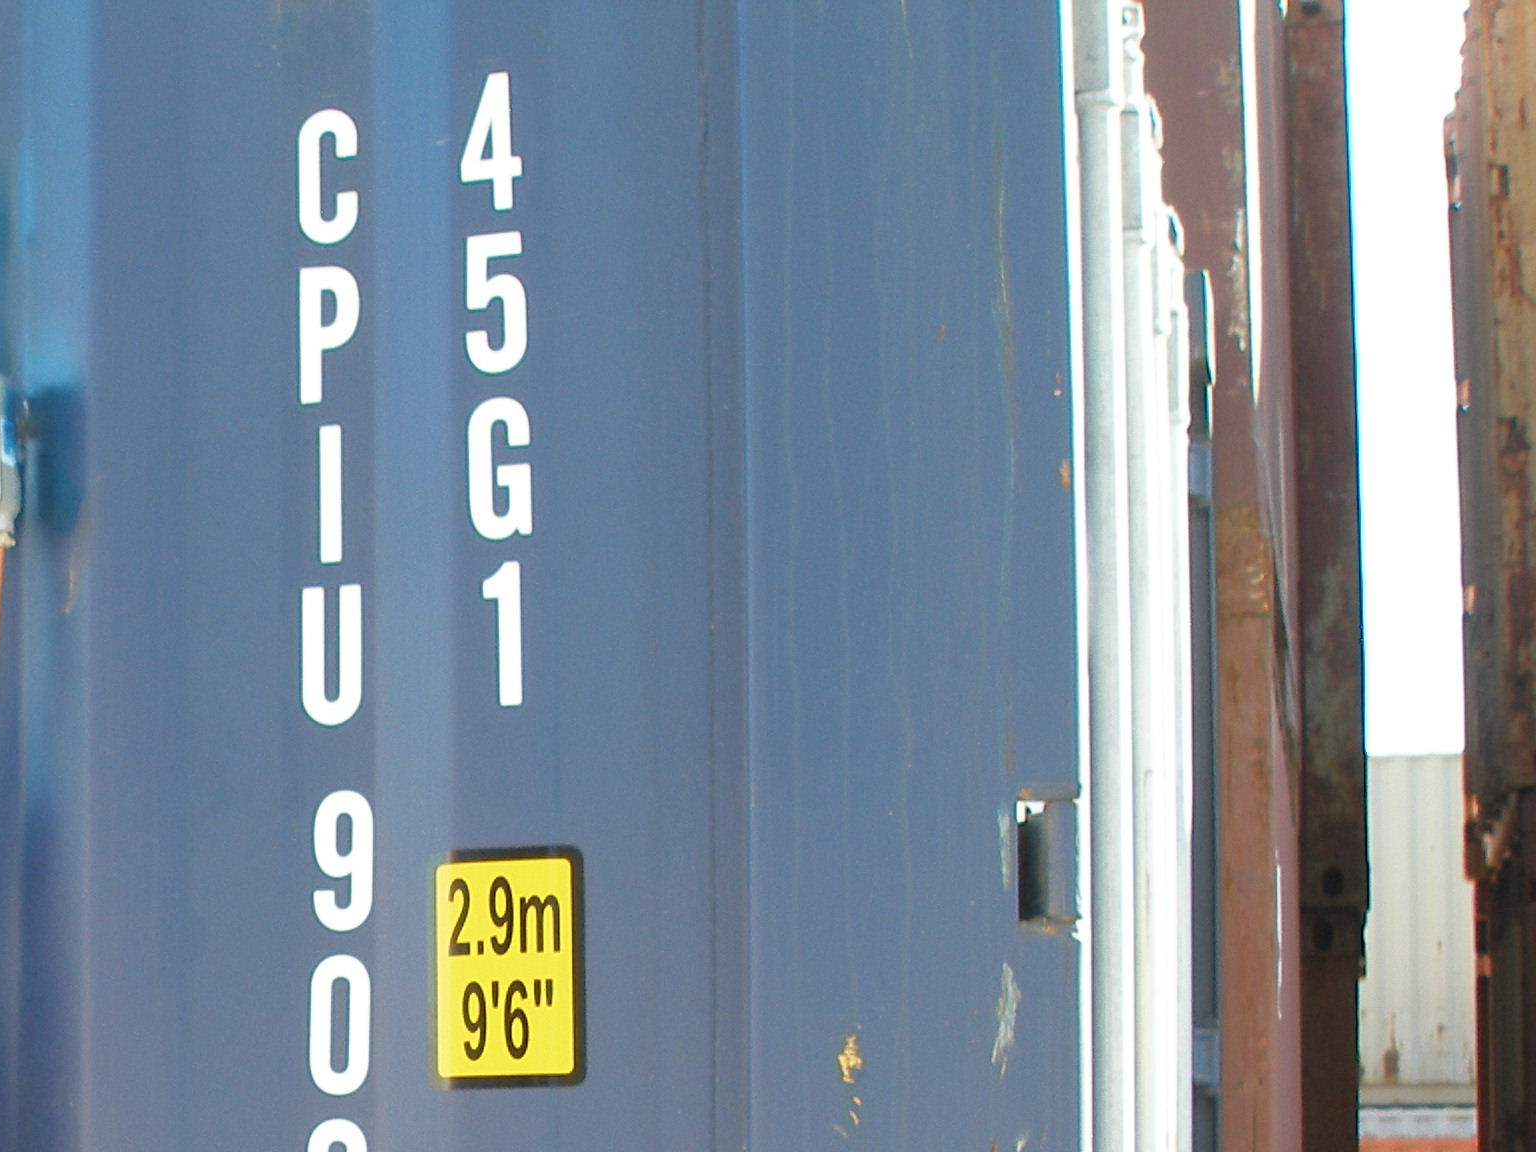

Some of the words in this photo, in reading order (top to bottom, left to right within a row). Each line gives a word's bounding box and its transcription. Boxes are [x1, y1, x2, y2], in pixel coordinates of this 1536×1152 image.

[297, 108, 363, 726] CPIU
[460, 71, 534, 708] 45G1
[448, 876, 560, 956] 2.9m
[462, 979, 553, 1060] 9'6"
